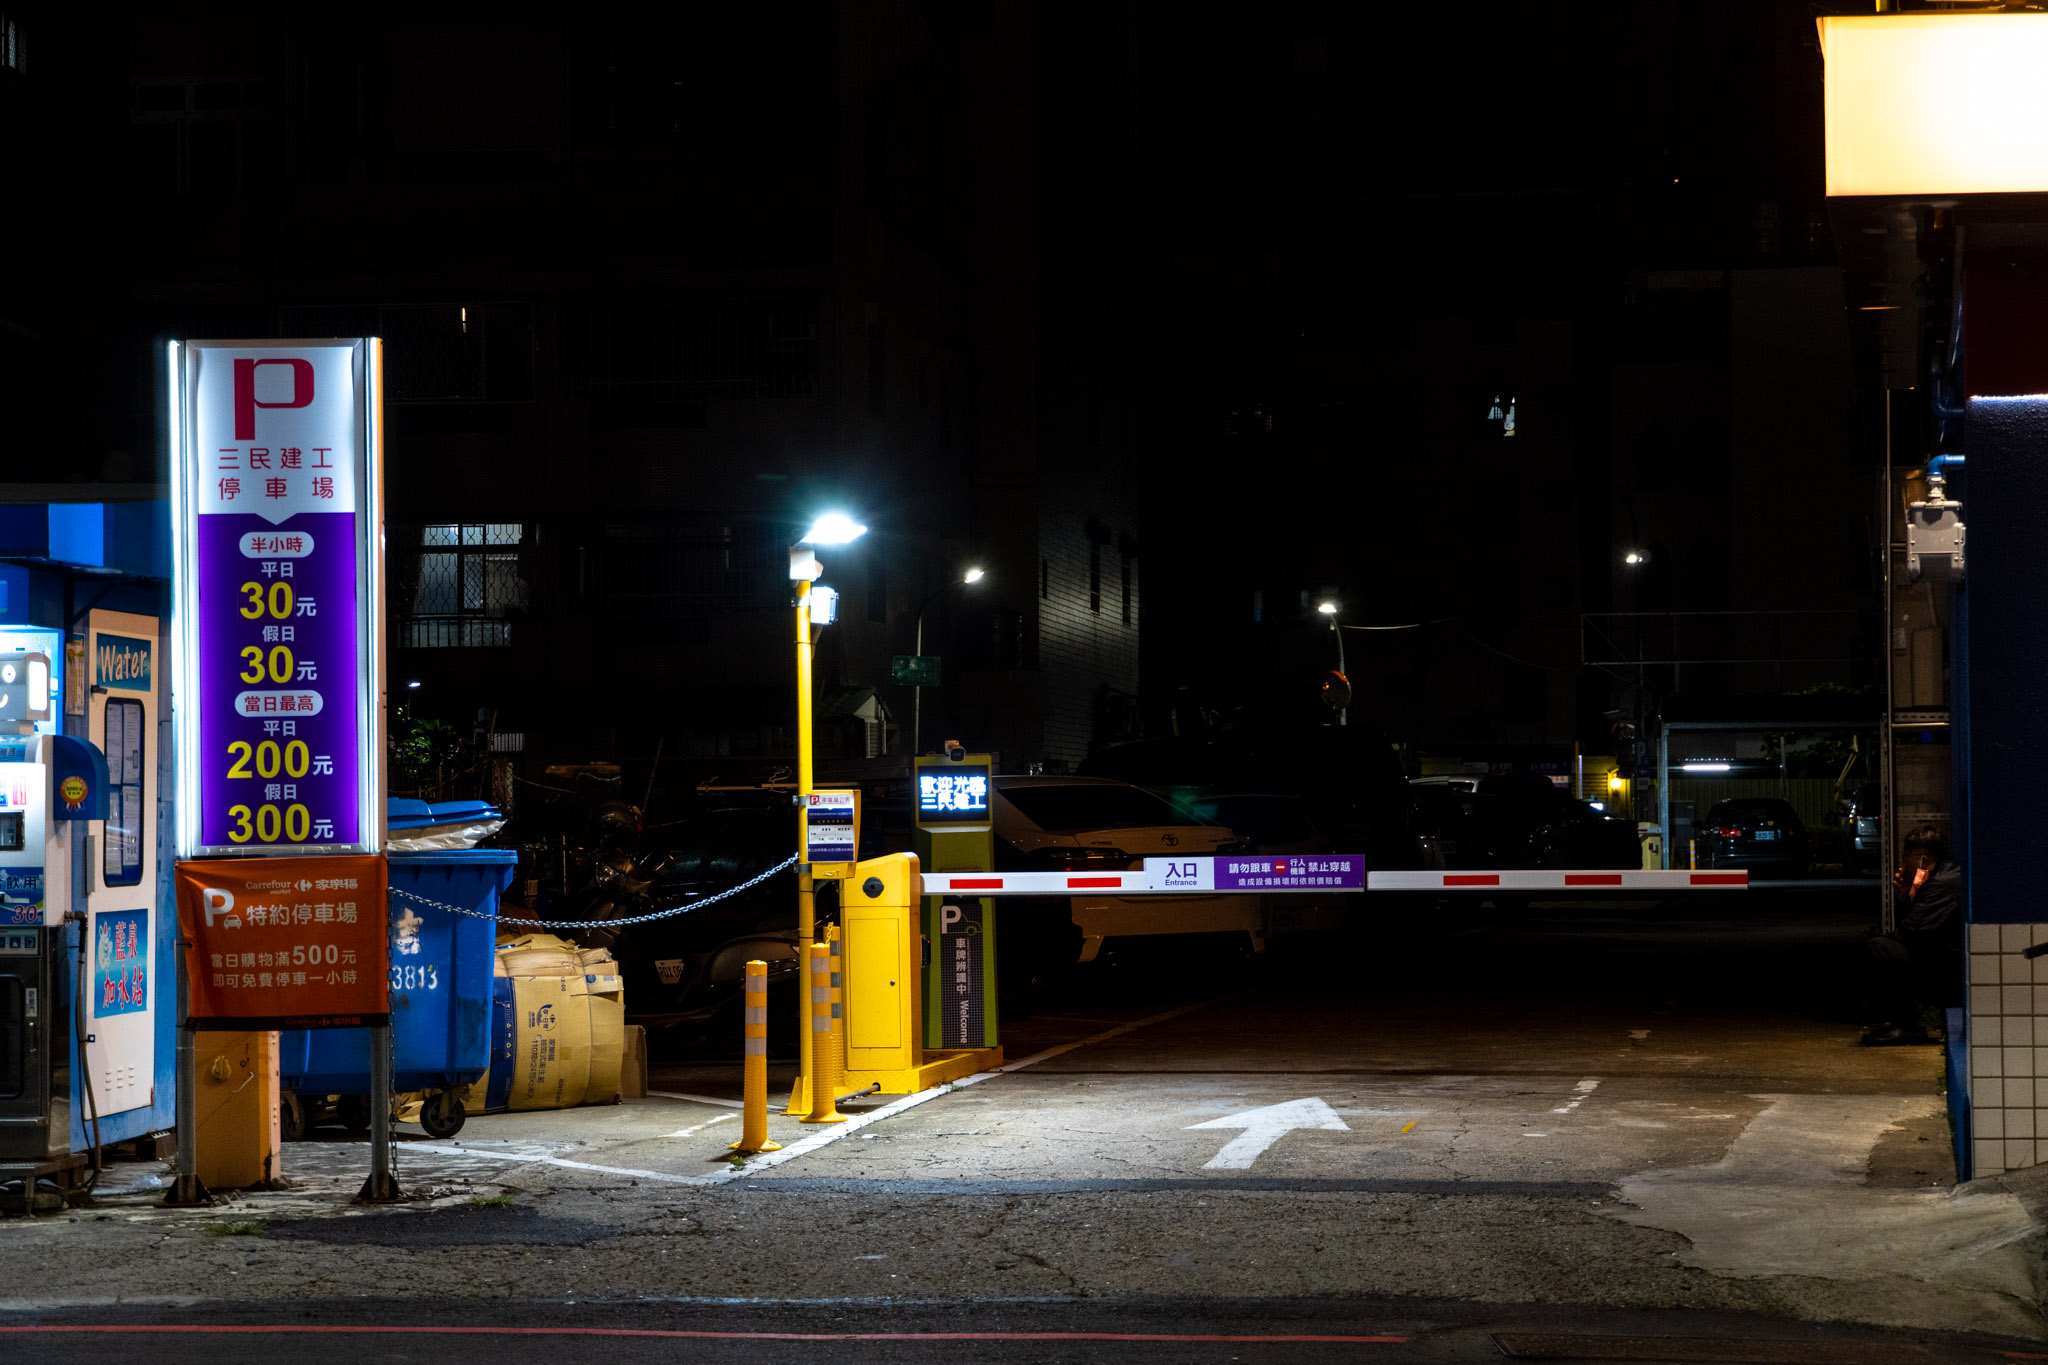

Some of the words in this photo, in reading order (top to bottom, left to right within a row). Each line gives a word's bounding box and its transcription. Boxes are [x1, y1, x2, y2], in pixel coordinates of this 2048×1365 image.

[234, 358, 314, 440] P
[218, 447, 334, 470] 三民建工
[218, 477, 334, 500] 停車場
[250, 536, 303, 553] 半小時
[261, 561, 294, 578] 平日
[262, 626, 295, 642] 假日
[100, 644, 148, 683] Water
[244, 695, 314, 713] 當日最高
[263, 720, 296, 737] 平日
[264, 784, 297, 800] 假日
[921, 792, 986, 810] 三民建工
[1165, 862, 1197, 878] 入口
[1229, 863, 1271, 874] 請勿跟車
[1290, 859, 1306, 867] 行人
[1290, 867, 1306, 876] 機車
[1308, 861, 1351, 872] 禁止穿越
[0, 876, 37, 890] 飲用
[246, 880, 292, 890] Carrefour
[203, 887, 235, 928] P
[246, 902, 358, 927] 特約停車場
[940, 905, 962, 934] P
[115, 919, 138, 961] 藍泉
[211, 944, 357, 968] 當日購物滿500元
[103, 964, 143, 1010] 加水站
[213, 970, 358, 988] 即可免費停車一小時
[959, 1000, 969, 1044] Welcome
